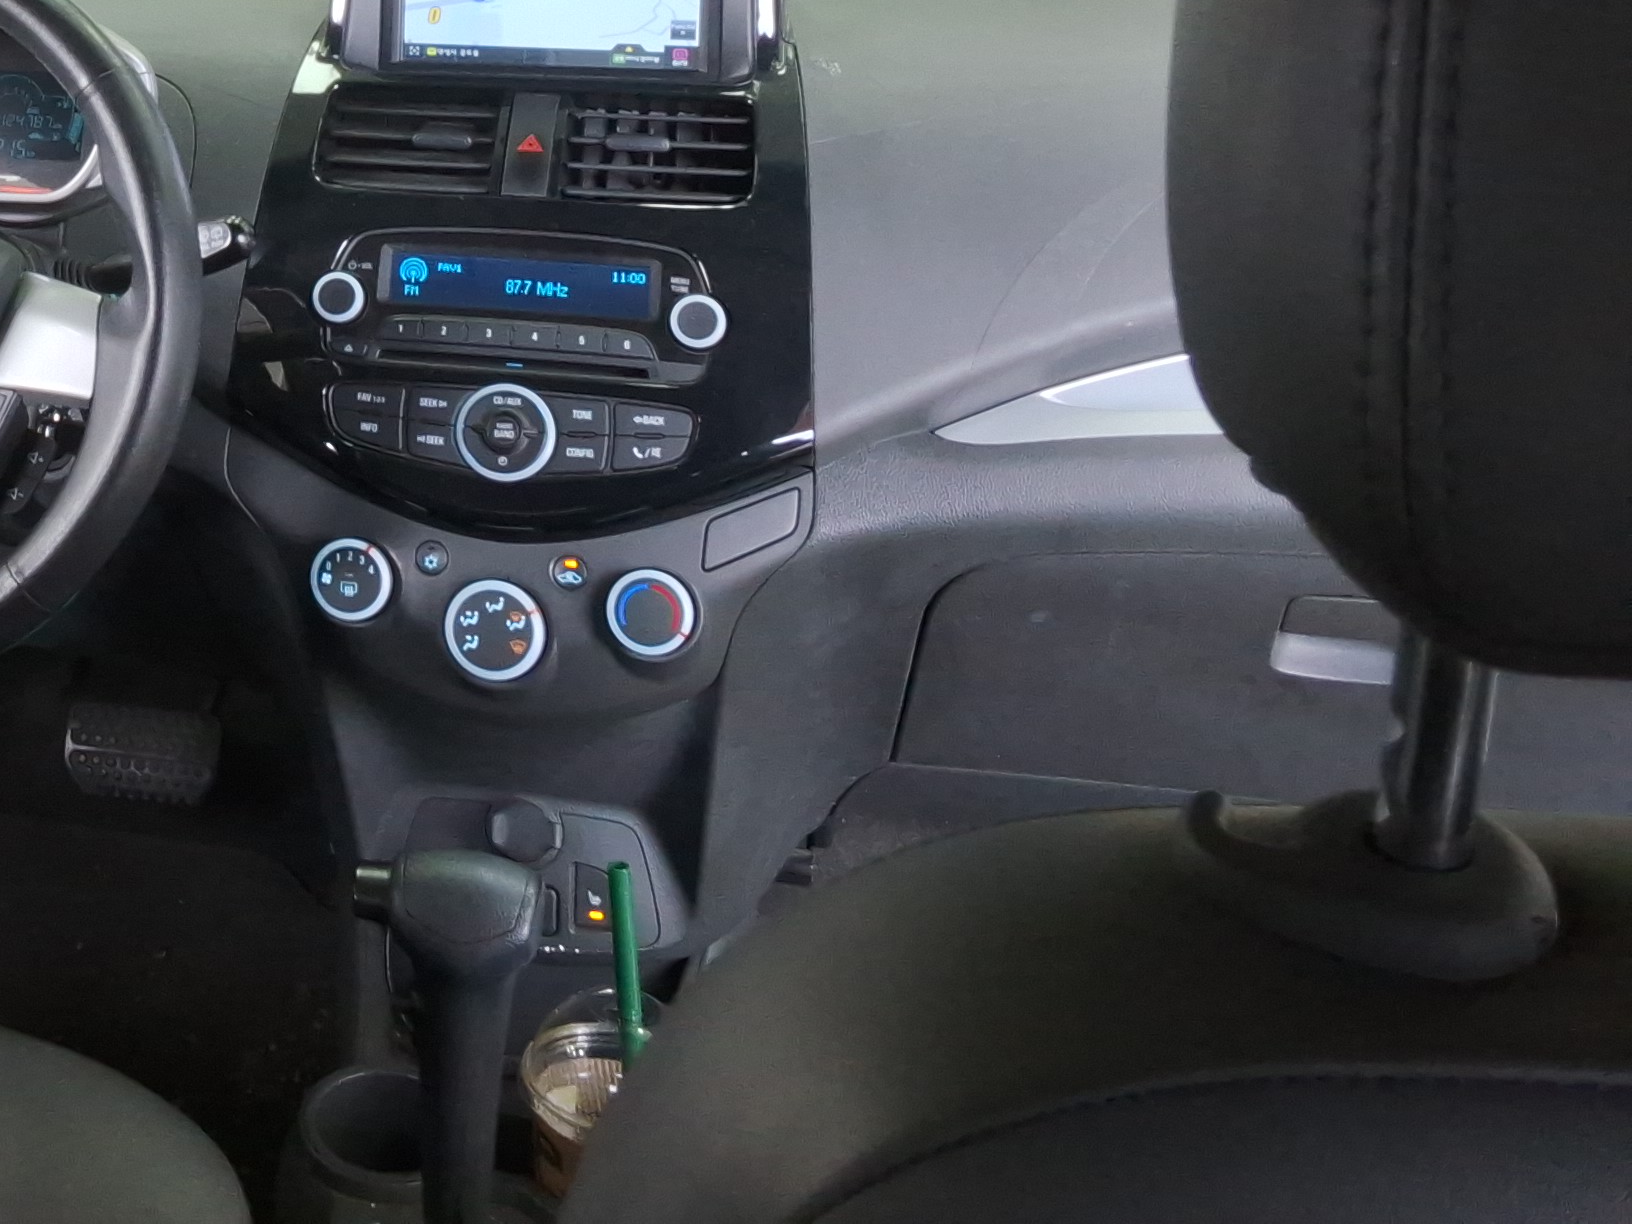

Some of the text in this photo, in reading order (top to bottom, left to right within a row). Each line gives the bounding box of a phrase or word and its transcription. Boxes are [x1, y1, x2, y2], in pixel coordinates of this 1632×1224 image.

[611, 271, 647, 285] 11:00
[505, 279, 569, 298] 87.7 MHz
